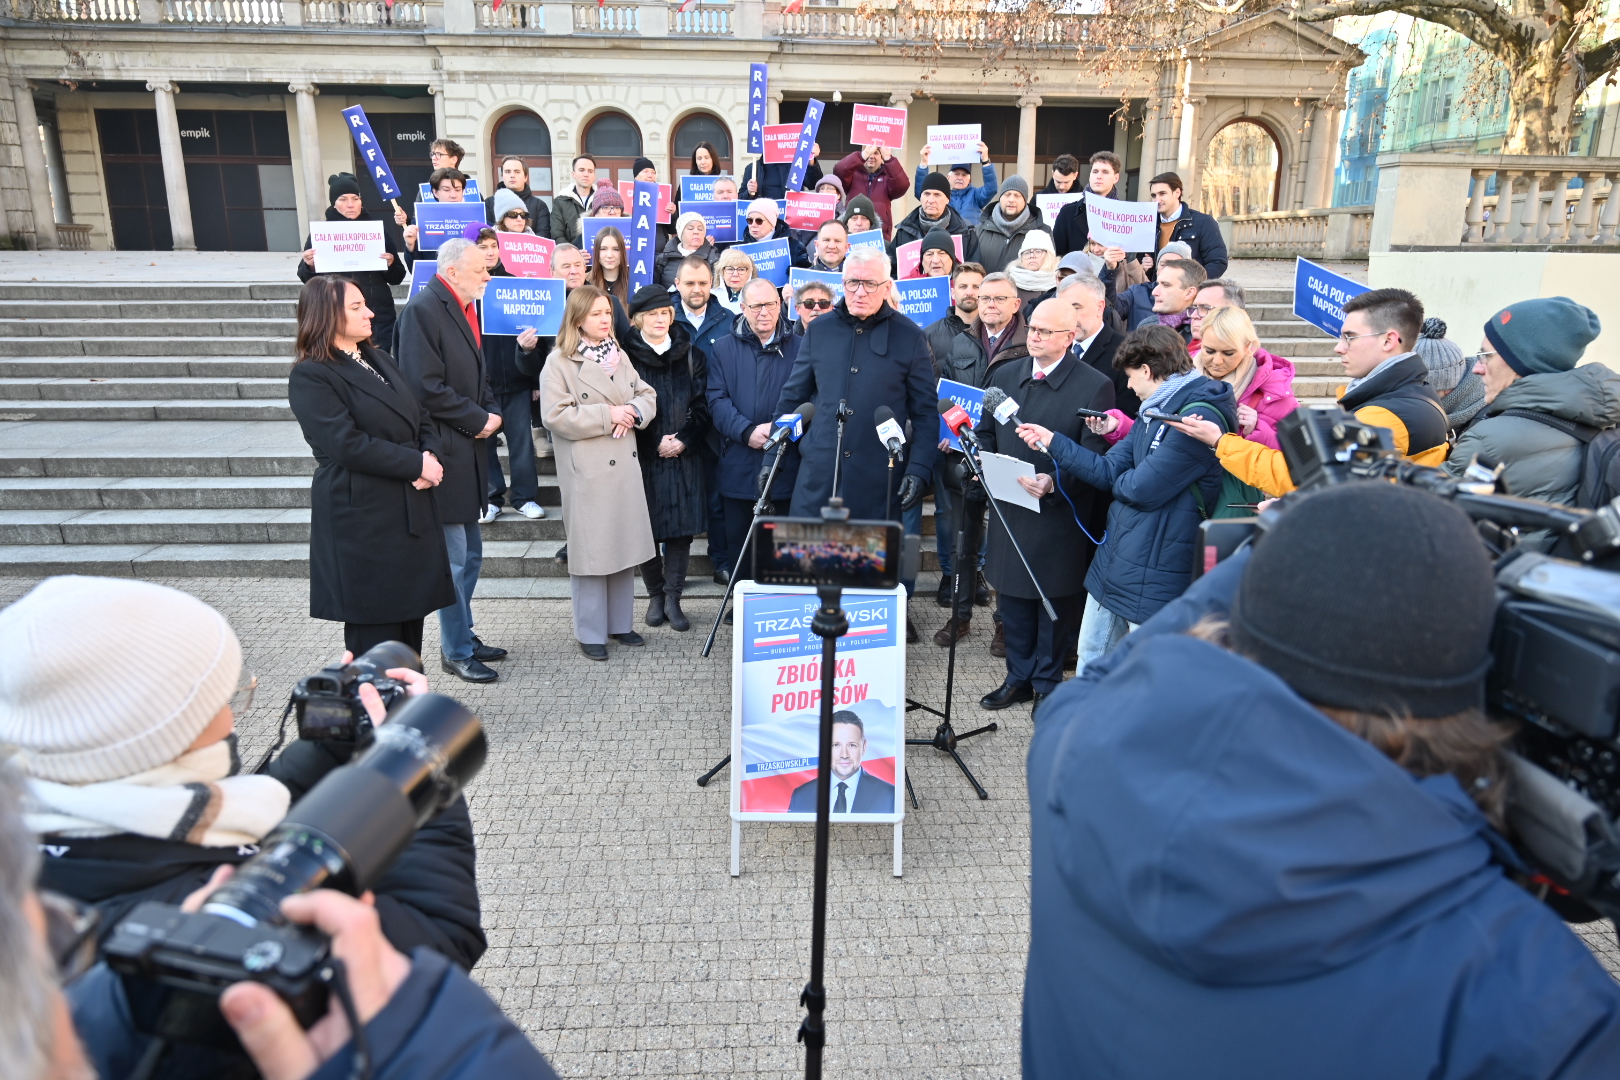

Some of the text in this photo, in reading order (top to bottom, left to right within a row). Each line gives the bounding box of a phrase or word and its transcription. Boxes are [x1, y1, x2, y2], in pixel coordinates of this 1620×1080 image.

[752, 70, 763, 148] RAFAŁ
[855, 113, 904, 126] CAŁA WIELKOPOLSKA
[180, 128, 211, 139] empik
[396, 131, 426, 142] empik
[764, 134, 777, 142] CAŁA
[790, 106, 818, 185] RAFAŁ
[349, 114, 394, 194] RAFAŁ
[689, 183, 704, 191] CAŁA
[694, 192, 714, 201] NAPRZ
[738, 208, 747, 217] AŁA
[1046, 202, 1060, 210] CAŁA
[1088, 203, 1154, 223] CAŁA WIELKOPOLSKA
[1101, 220, 1133, 235] NAPRZÓD!
[314, 232, 382, 242] CAŁA WIELKOPOLSKA
[333, 242, 366, 252] NAPRZÓD!
[504, 241, 548, 254] CAŁA POLSKA
[511, 253, 545, 264] NAPRZÓD!
[907, 250, 920, 260] CAŁ
[495, 288, 552, 301] CAŁA POLSKA
[908, 287, 938, 301] POLSKA
[1307, 275, 1354, 306] CAŁA POLS
[503, 302, 545, 316] NAPRZÓD!
[900, 301, 933, 315] APRZÓD!
[754, 607, 888, 633] TRZASWSKI
[850, 638, 871, 646] POLSKI
[776, 656, 857, 686] ZBIÓKA
[771, 679, 869, 713] PODPSÓW
[757, 757, 810, 772] TRZASKOWSKI.PL
